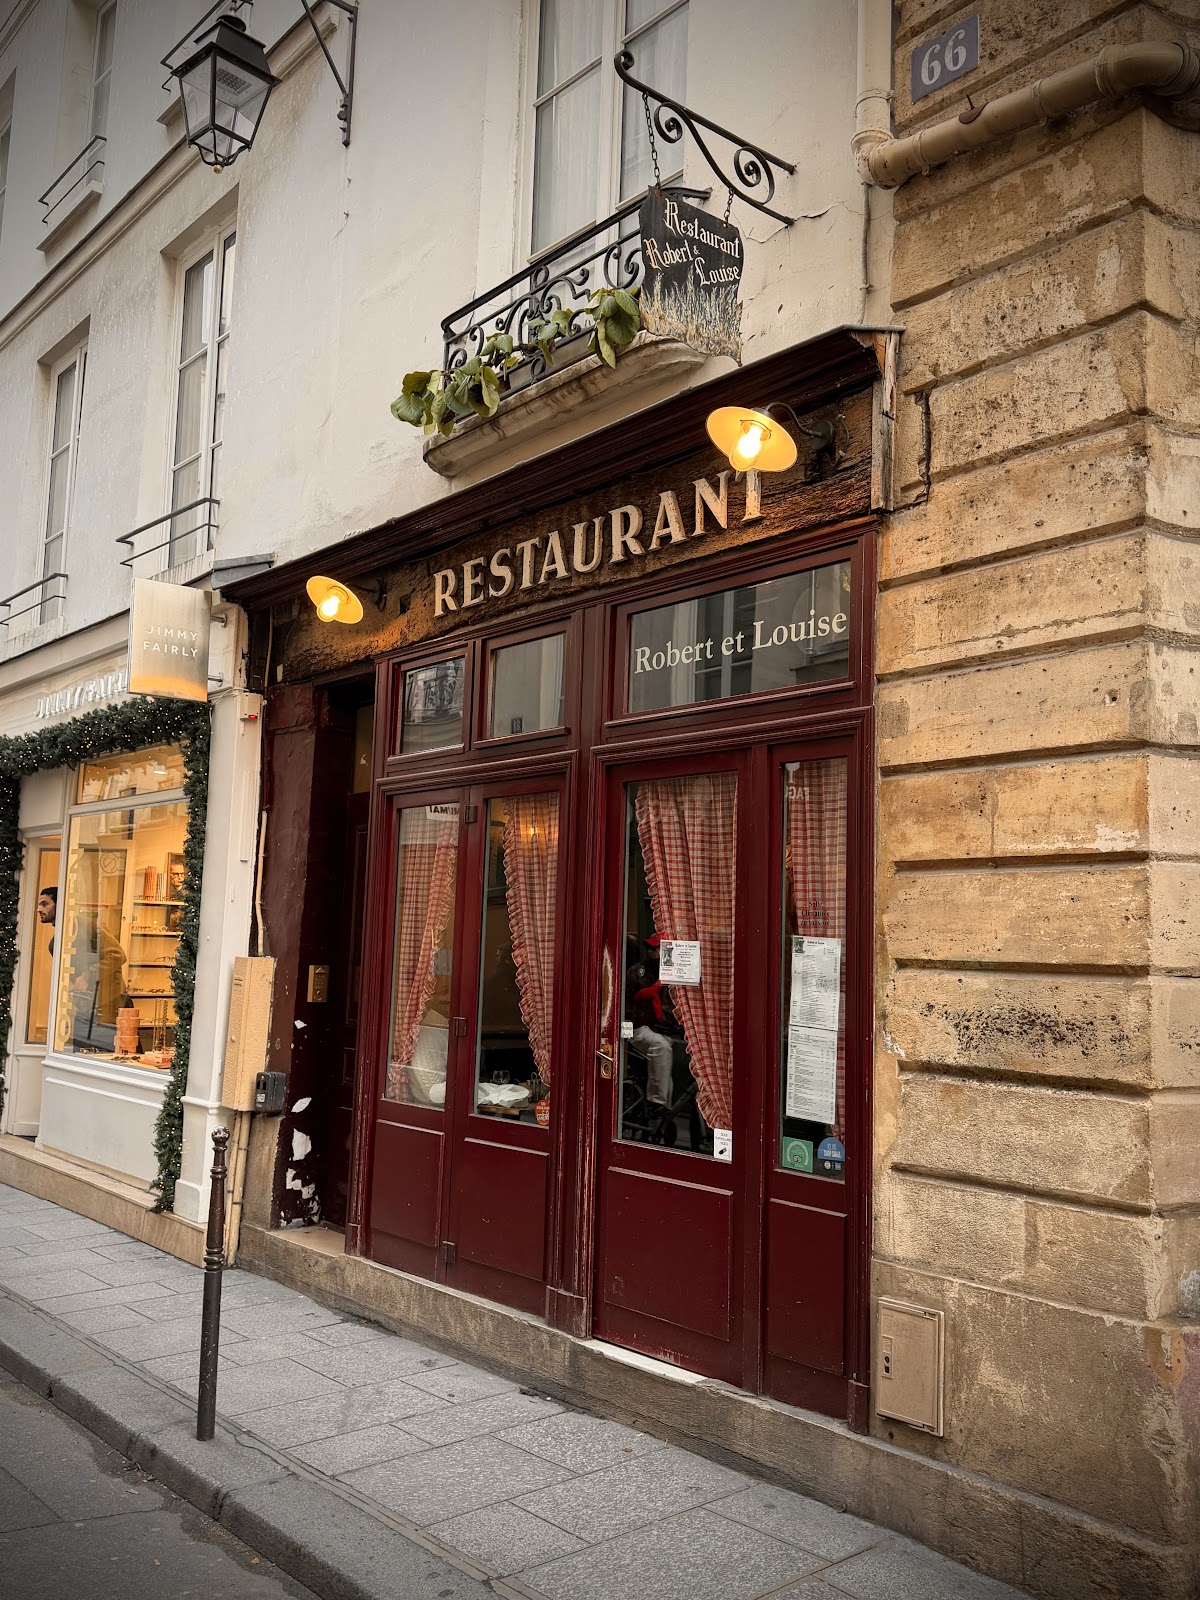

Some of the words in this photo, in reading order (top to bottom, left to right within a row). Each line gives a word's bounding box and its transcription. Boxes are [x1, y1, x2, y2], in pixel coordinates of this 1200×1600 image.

[921, 29, 967, 86] 66
[662, 198, 740, 259] Restaurant
[643, 237, 695, 271] Robert
[693, 257, 741, 286] Louise
[433, 469, 767, 618] RESTAURANT
[143, 640, 198, 658] FAIRLY
[146, 625, 198, 641] JIMMY
[634, 636, 714, 674] Robert
[721, 630, 745, 657] et
[751, 608, 848, 650] Louise
